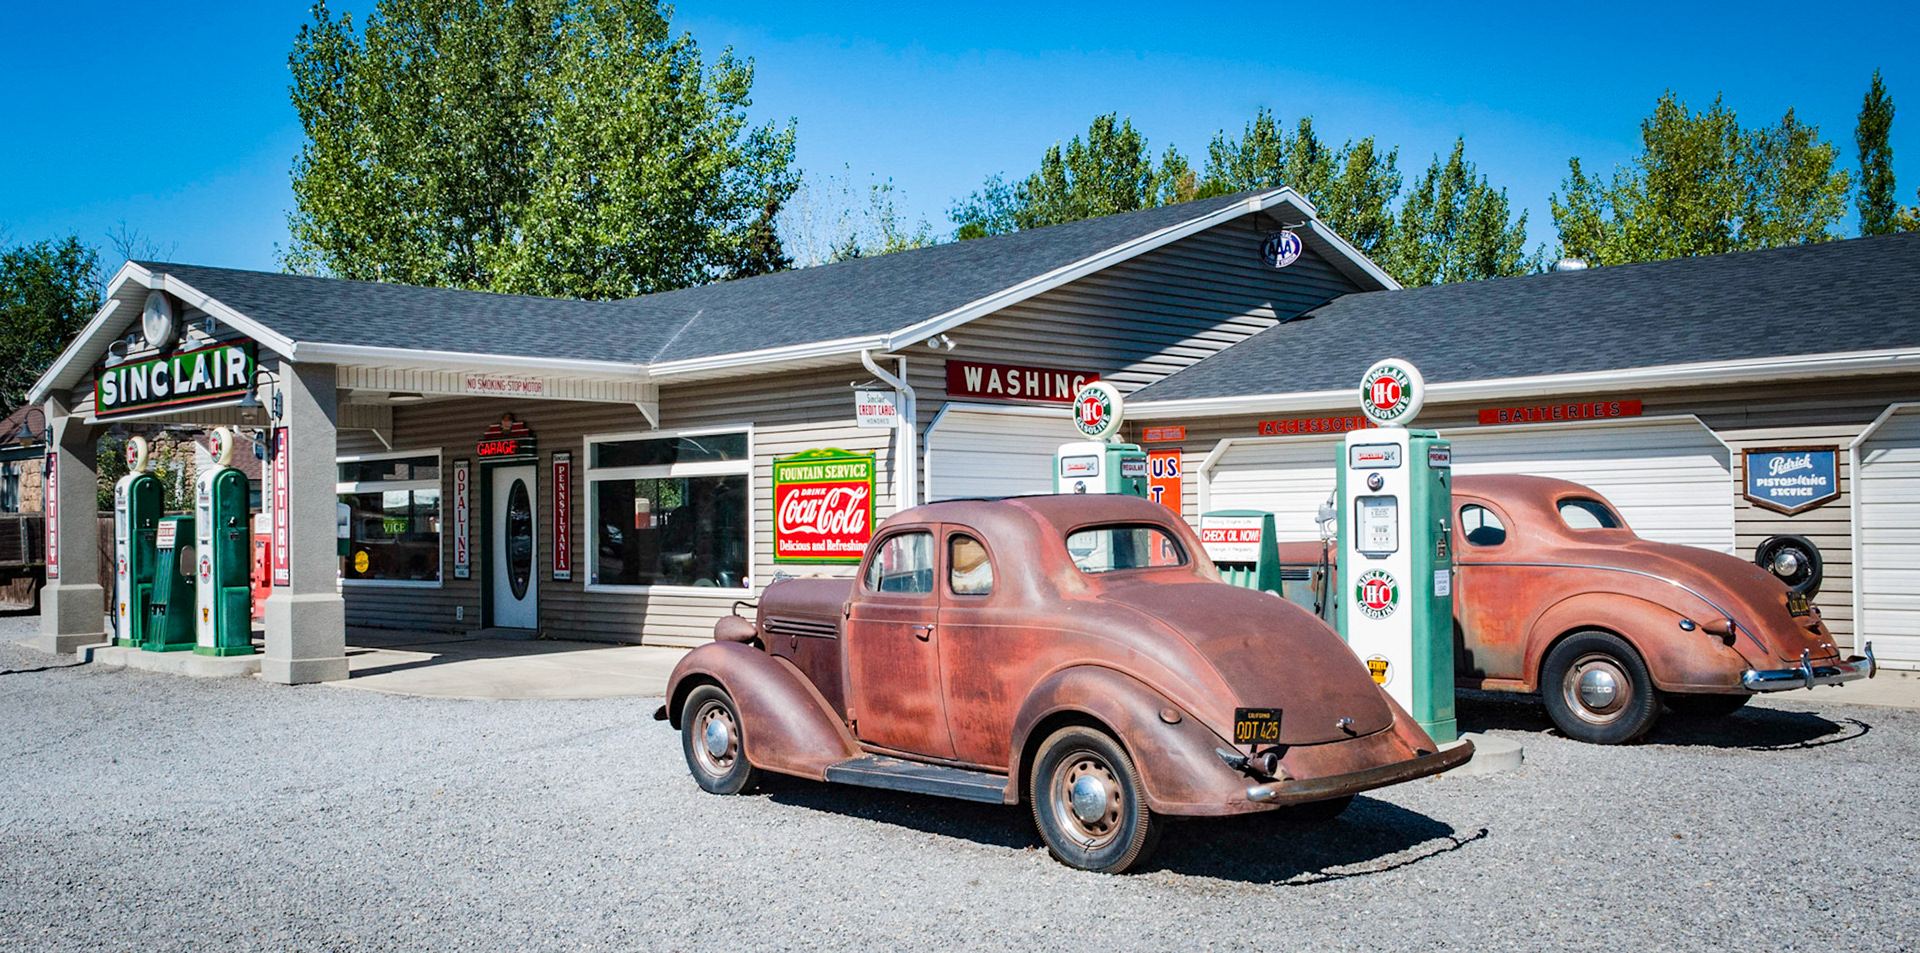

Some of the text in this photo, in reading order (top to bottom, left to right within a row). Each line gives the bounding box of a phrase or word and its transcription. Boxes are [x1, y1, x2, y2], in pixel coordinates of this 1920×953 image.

[1268, 240, 1292, 261] AAA
[102, 347, 247, 405] SINCLAIR
[467, 378, 476, 389] NO
[523, 380, 542, 393] MOTOR
[964, 366, 1086, 400] WASHING
[1364, 367, 1409, 390] SINCLAIR
[1076, 388, 1109, 407] SINCLAIR
[858, 404, 896, 416] CREDIT CARDS
[1364, 396, 1410, 419] GASOLINE
[1498, 402, 1621, 422] BATTERIES
[1076, 413, 1111, 434] GASOLINE
[1264, 417, 1375, 433] ACCESSORIE
[477, 440, 516, 456] GARAGE
[780, 463, 867, 481] FOUNTAIN SERVICE
[1152, 459, 1180, 478] U.S.
[1769, 453, 1813, 476] Pedrick
[277, 432, 286, 566] CENTURY
[801, 488, 828, 496] DRINK
[457, 469, 466, 564] OPALINE
[558, 466, 566, 568] PENNSYLVANIA
[778, 486, 868, 535] Coca-Cola
[1203, 529, 1260, 542] CHECK OIL NOW!
[779, 538, 868, 553] Delicious and Refreshing
[1357, 570, 1396, 589] SINCLAIR
[1358, 600, 1397, 619] GASOLINE
[1260, 721, 1279, 740] 425
